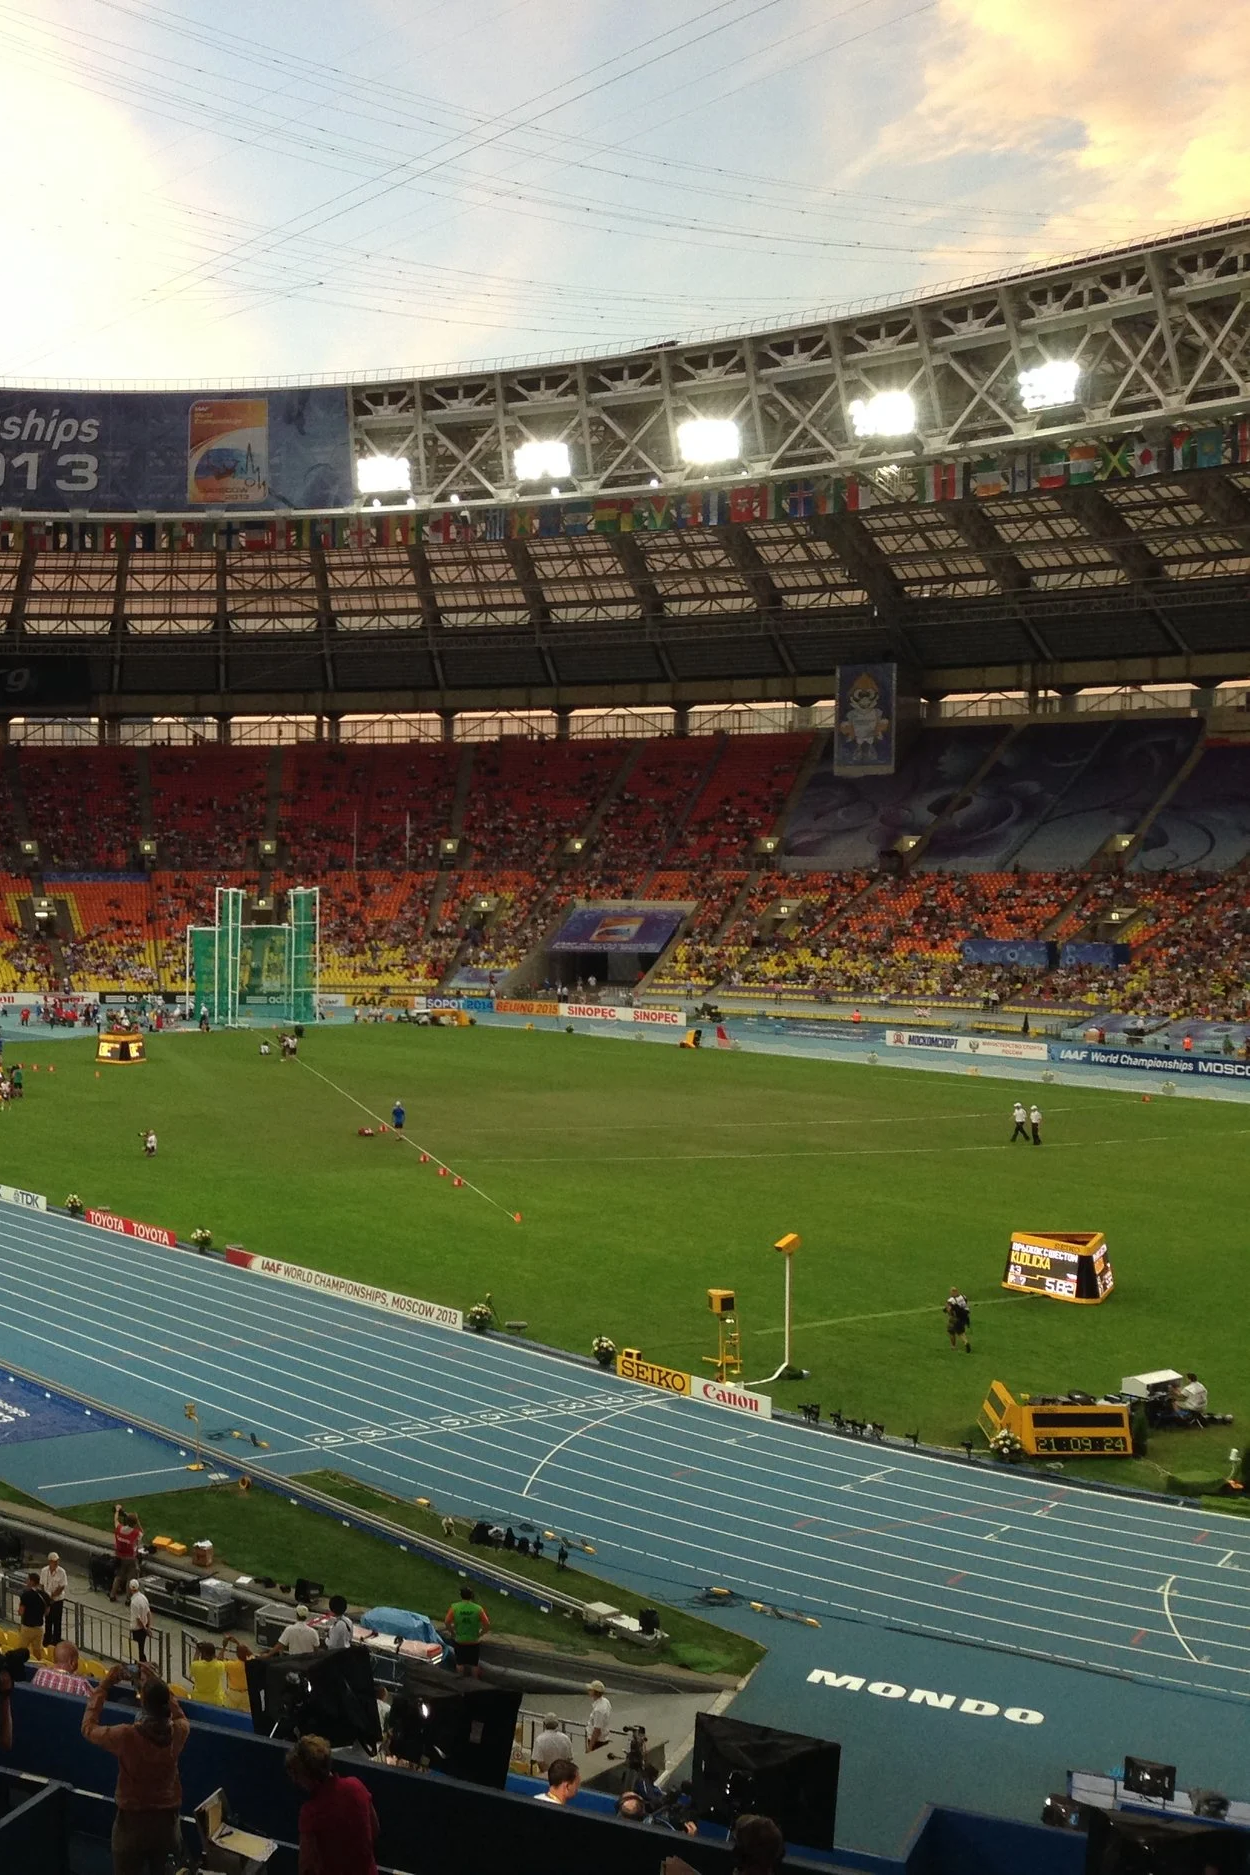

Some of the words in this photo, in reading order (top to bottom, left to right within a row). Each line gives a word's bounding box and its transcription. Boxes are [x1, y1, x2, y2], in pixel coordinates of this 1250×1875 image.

[426, 998, 464, 1009] SOPOT
[467, 1001, 494, 1011] 2014
[497, 1001, 535, 1014] BEIJING
[537, 1003, 558, 1014] 2015
[568, 1005, 616, 1019] SINOPEC
[633, 1010, 678, 1023] SINOPEC
[1060, 1049, 1088, 1061] IAAF
[1091, 1051, 1118, 1064] World
[1120, 1054, 1193, 1072] Championships
[19, 1190, 39, 1209] TDK
[89, 1210, 124, 1232] TOYOTA
[132, 1222, 169, 1245] TOYOTA
[261, 1259, 283, 1274] IAAF
[283, 1266, 313, 1284] WORLD
[314, 1274, 389, 1307] CHAMPIONSHIPS,
[391, 1294, 435, 1318] MOSCOW
[436, 1309, 458, 1325] 2013
[622, 1359, 685, 1392] SEIKO
[703, 1383, 759, 1412] Canon
[806, 1668, 1045, 1725] MONDO
